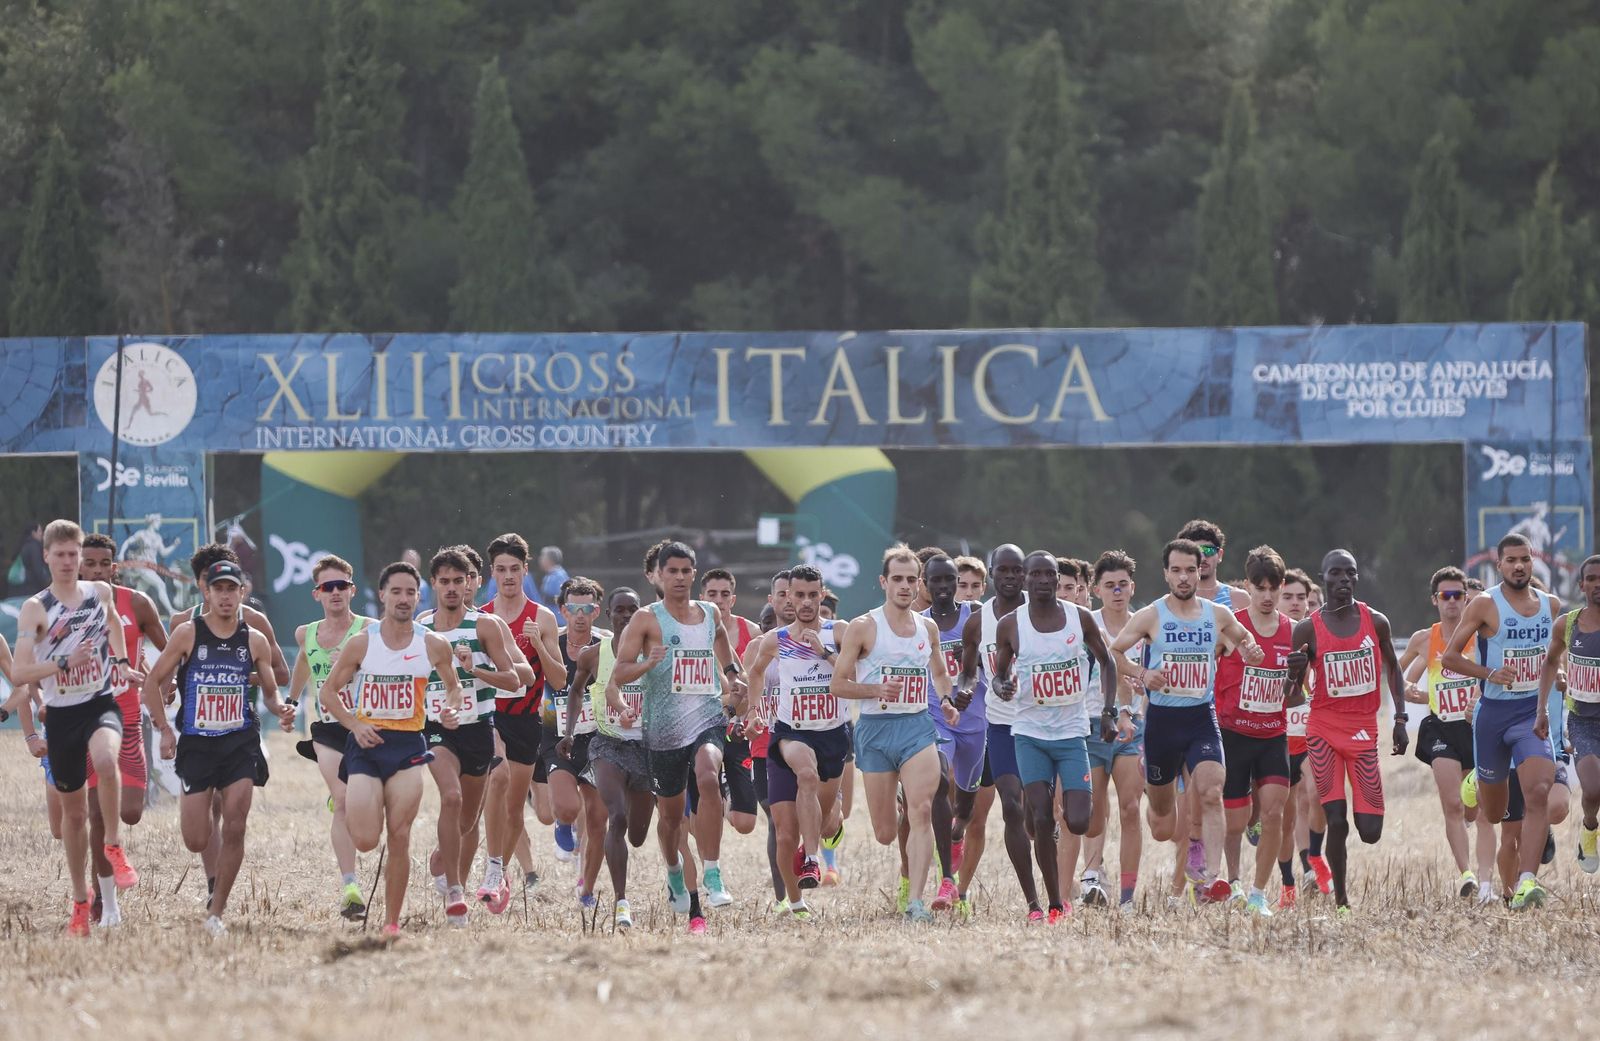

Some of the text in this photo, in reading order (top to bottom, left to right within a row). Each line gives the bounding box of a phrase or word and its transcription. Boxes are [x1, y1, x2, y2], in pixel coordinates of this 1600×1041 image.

[713, 331, 1114, 426] ITÁLICA
[1253, 358, 1554, 382] CAMPEONATO DE ANDALUCÍA
[256, 352, 636, 421] XLIII CROSS
[1302, 382, 1329, 400] DE
[1331, 381, 1407, 400] CAMPO
[1412, 381, 1426, 398] A
[473, 397, 696, 421] INTERNACIONAL
[1347, 398, 1467, 418] POR CLUBES
[256, 424, 657, 448] INTERNATIONAL CROSS COUNTRY
[144, 473, 189, 487] Sevilla
[1165, 628, 1212, 646] nerja
[1506, 624, 1549, 642] nerja
[1032, 666, 1082, 699] KOECH
[1327, 656, 1375, 689] ALAMISI
[197, 694, 242, 722] ATRIKI
[363, 682, 413, 710] FONTES
[792, 693, 839, 721] AFERDI
